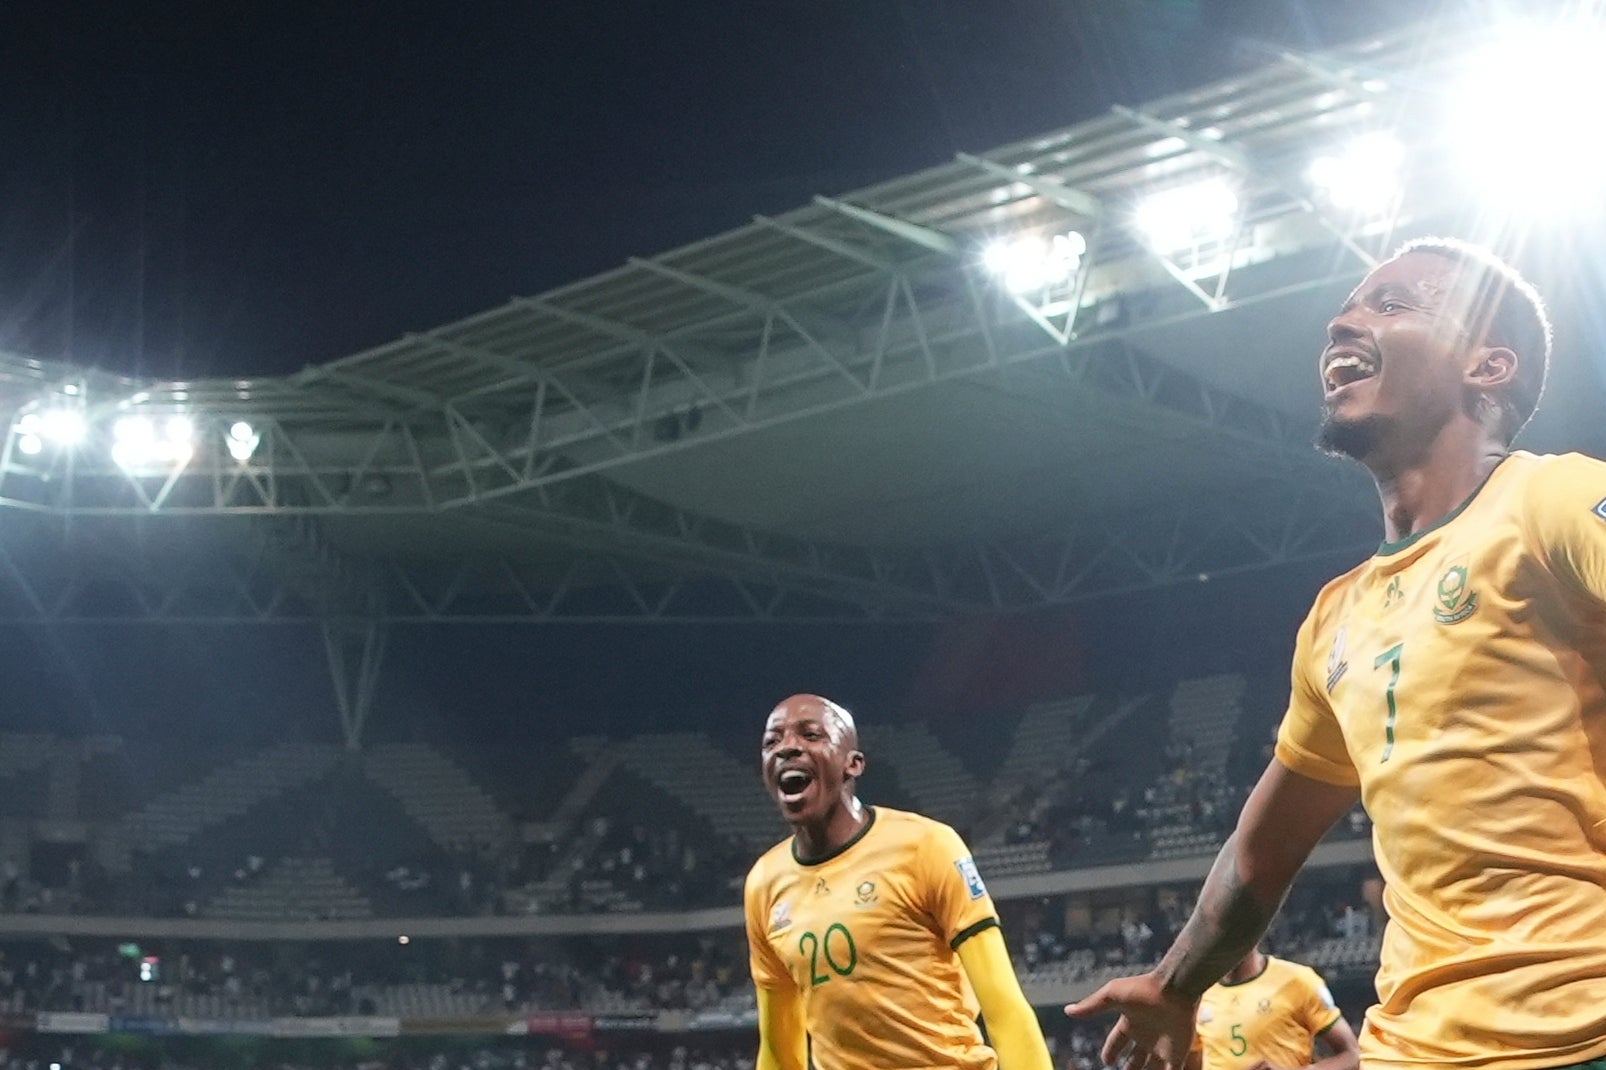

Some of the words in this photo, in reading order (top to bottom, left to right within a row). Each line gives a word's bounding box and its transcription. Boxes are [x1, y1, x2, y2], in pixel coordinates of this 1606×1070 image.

[1373, 642, 1404, 763] 7
[798, 923, 857, 987] 20
[1229, 1025, 1247, 1057] 5
